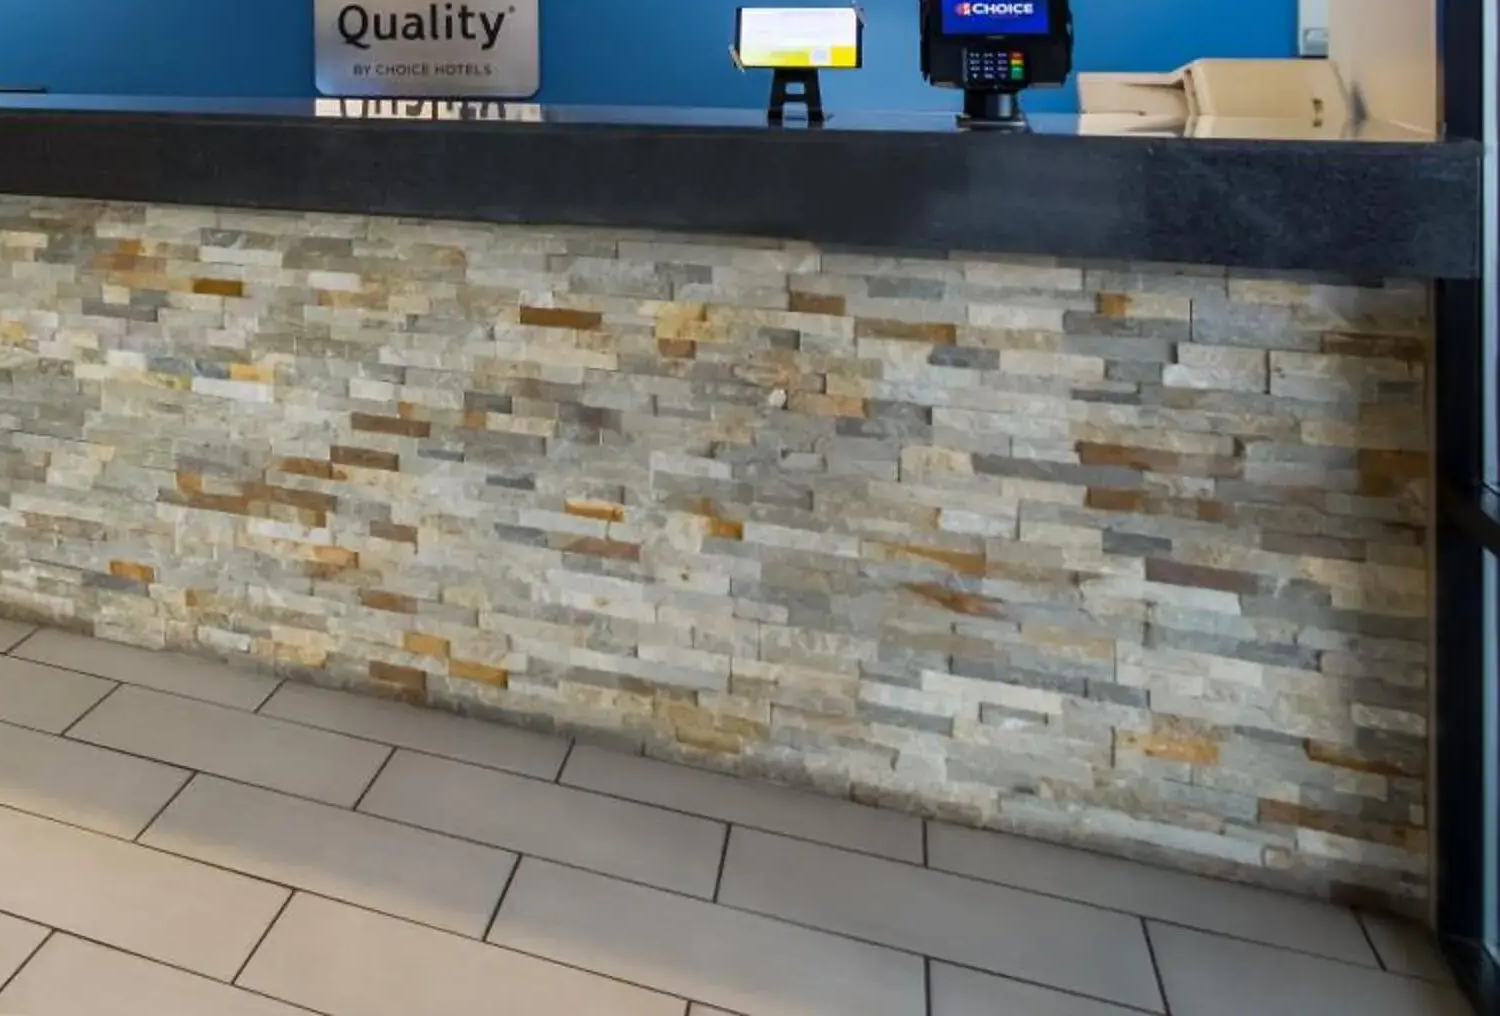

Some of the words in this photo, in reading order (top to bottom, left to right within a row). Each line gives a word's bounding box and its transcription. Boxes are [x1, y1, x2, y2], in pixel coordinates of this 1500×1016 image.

[972, 3, 1034, 15] CHOICE
[338, 3, 505, 50] Quality
[352, 63, 371, 77] BY
[375, 63, 430, 77] CHOICE
[434, 63, 493, 77] HOTELS
